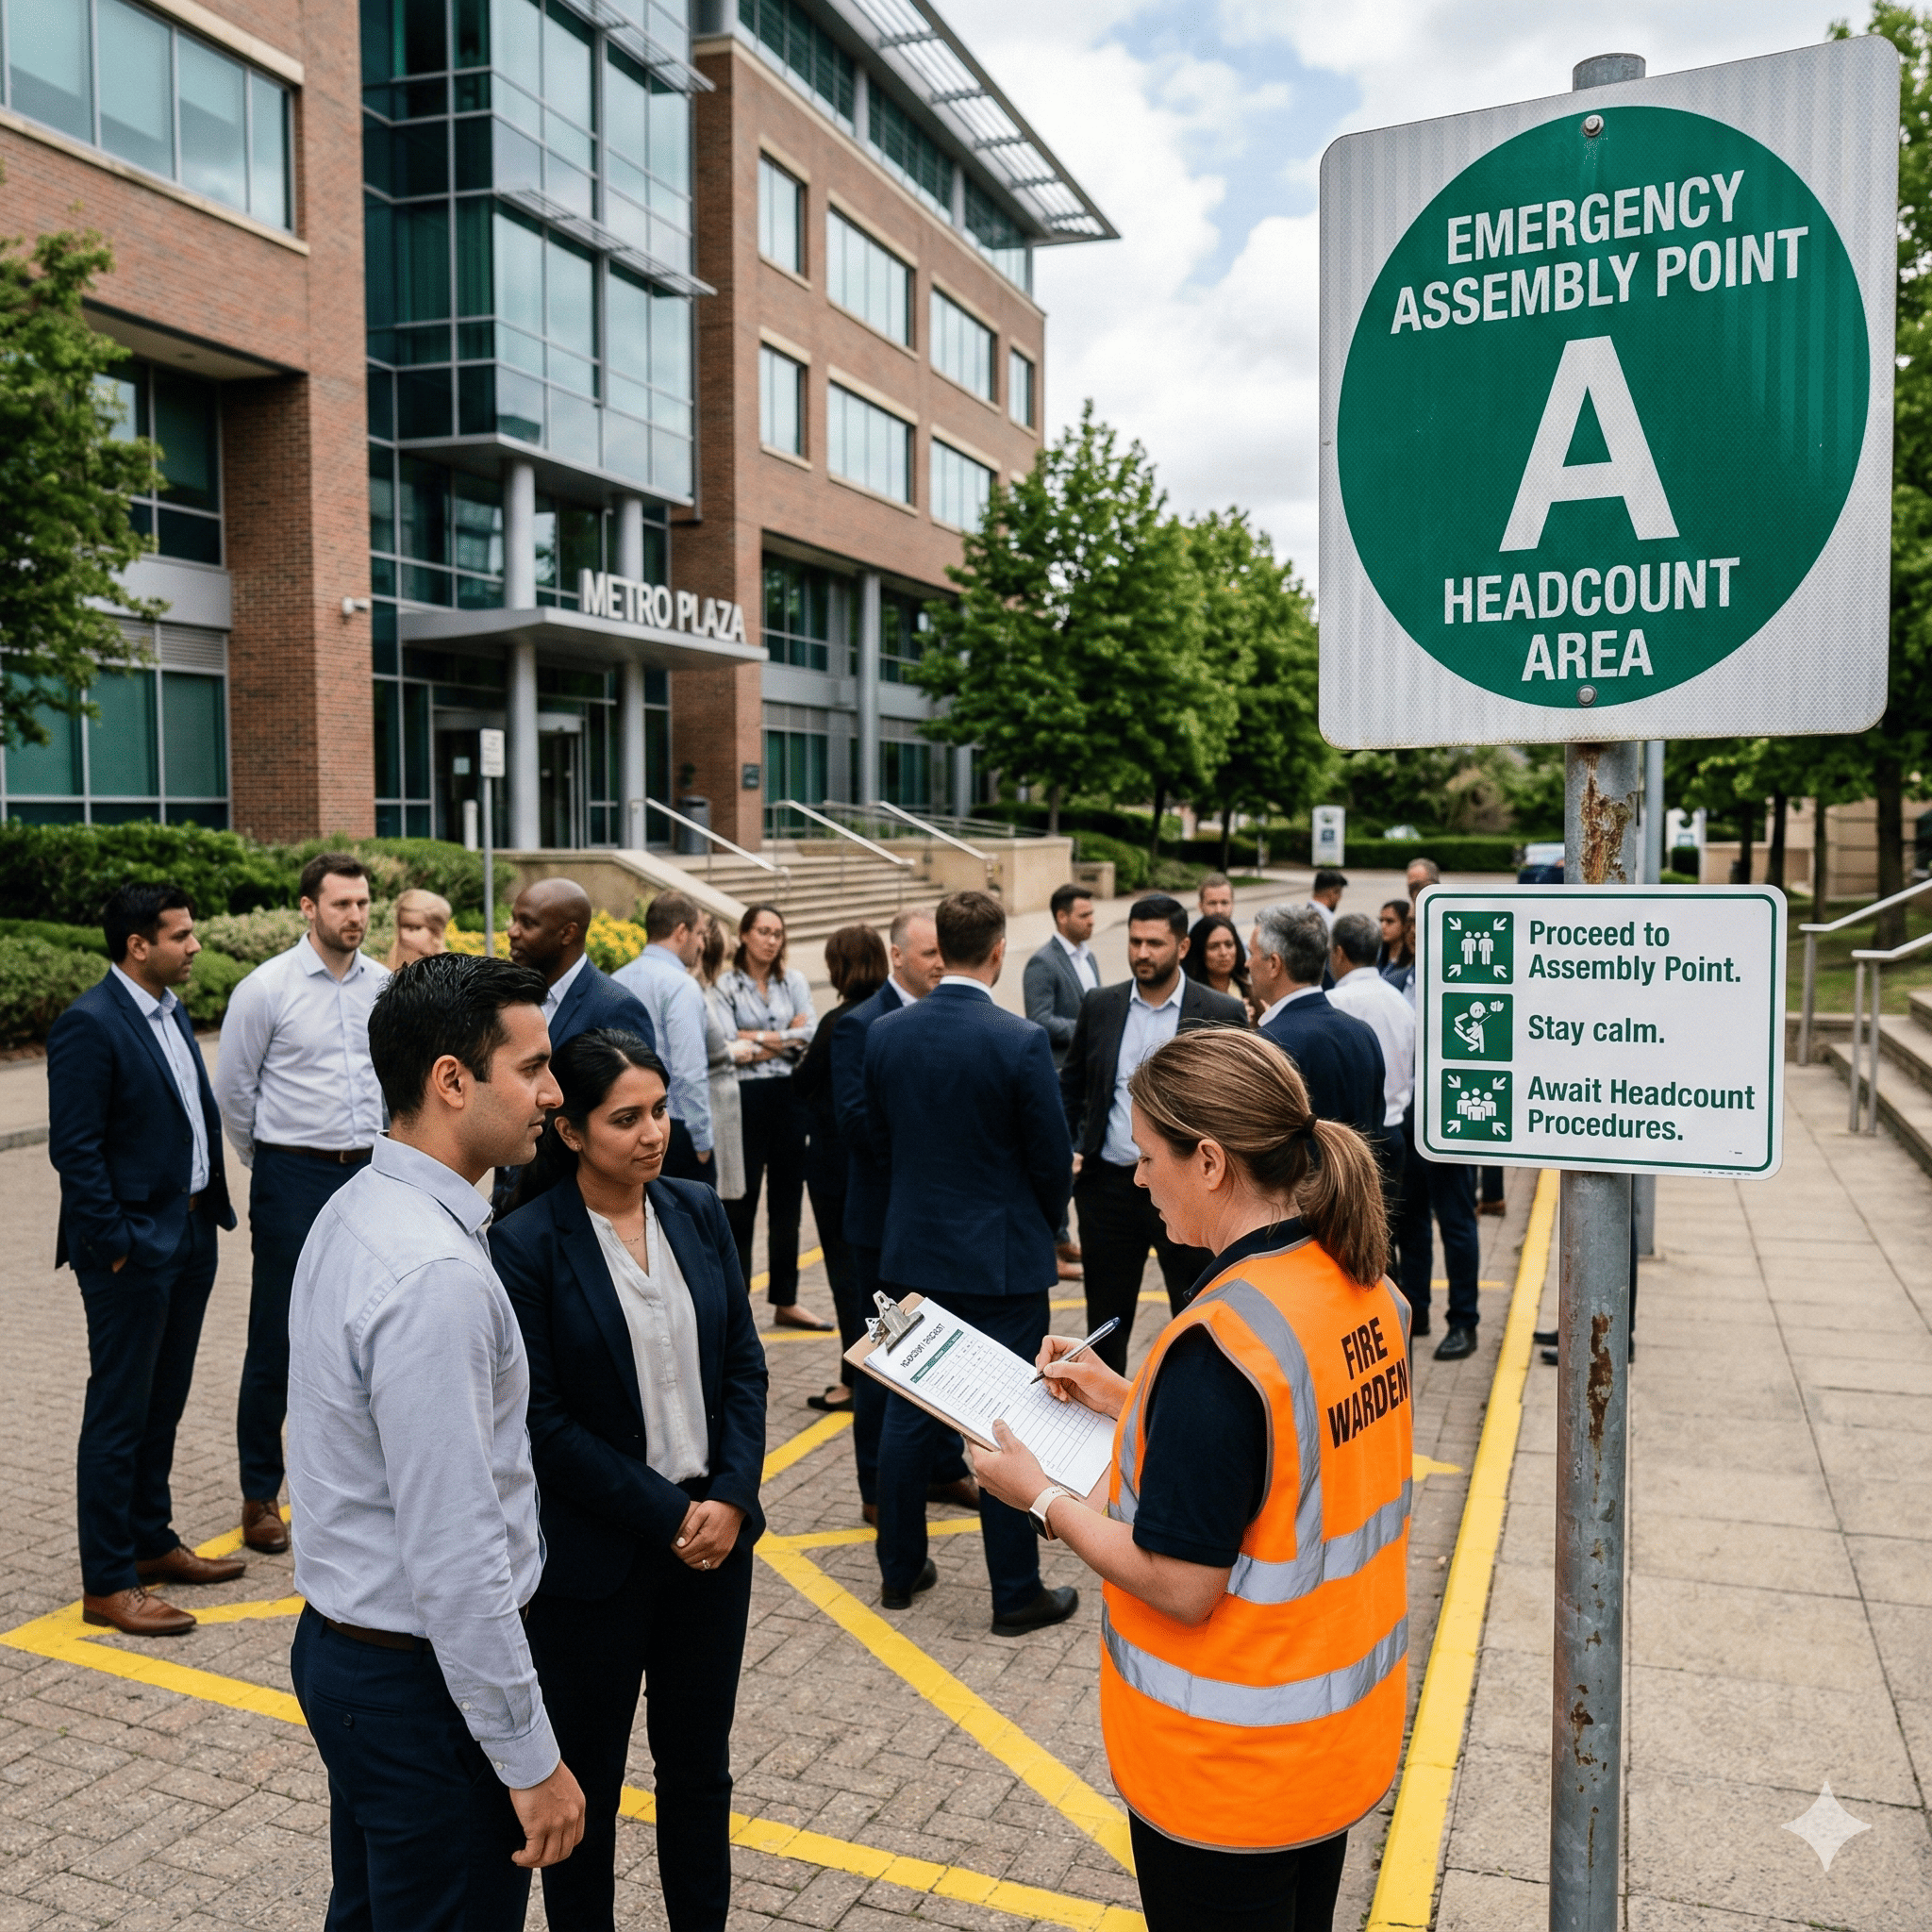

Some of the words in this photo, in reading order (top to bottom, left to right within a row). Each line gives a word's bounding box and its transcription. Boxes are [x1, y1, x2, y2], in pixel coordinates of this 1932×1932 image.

[1448, 170, 1744, 264] EMERGENCY
[1391, 252, 1640, 334] ASSEMBLY
[1657, 226, 1808, 296] POINT
[1499, 336, 1679, 552] A
[580, 567, 674, 630] METRO
[676, 590, 747, 644] PLAZA
[1445, 558, 1740, 624] HEADCOUNT
[1522, 629, 1654, 681] AREA
[1530, 921, 1634, 946] Proceed
[1644, 923, 1669, 946] to
[1529, 955, 1656, 986] Assembly
[1666, 957, 1740, 982] Point.
[1528, 1015, 1584, 1046] Stay
[1593, 1018, 1664, 1043] calm.
[1528, 1076, 1601, 1103] Await
[1611, 1079, 1755, 1109] Headcount
[1529, 1109, 1683, 1141] Procedures.
[1341, 1317, 1388, 1379] FIRE
[1327, 1357, 1408, 1450] WARDEN
